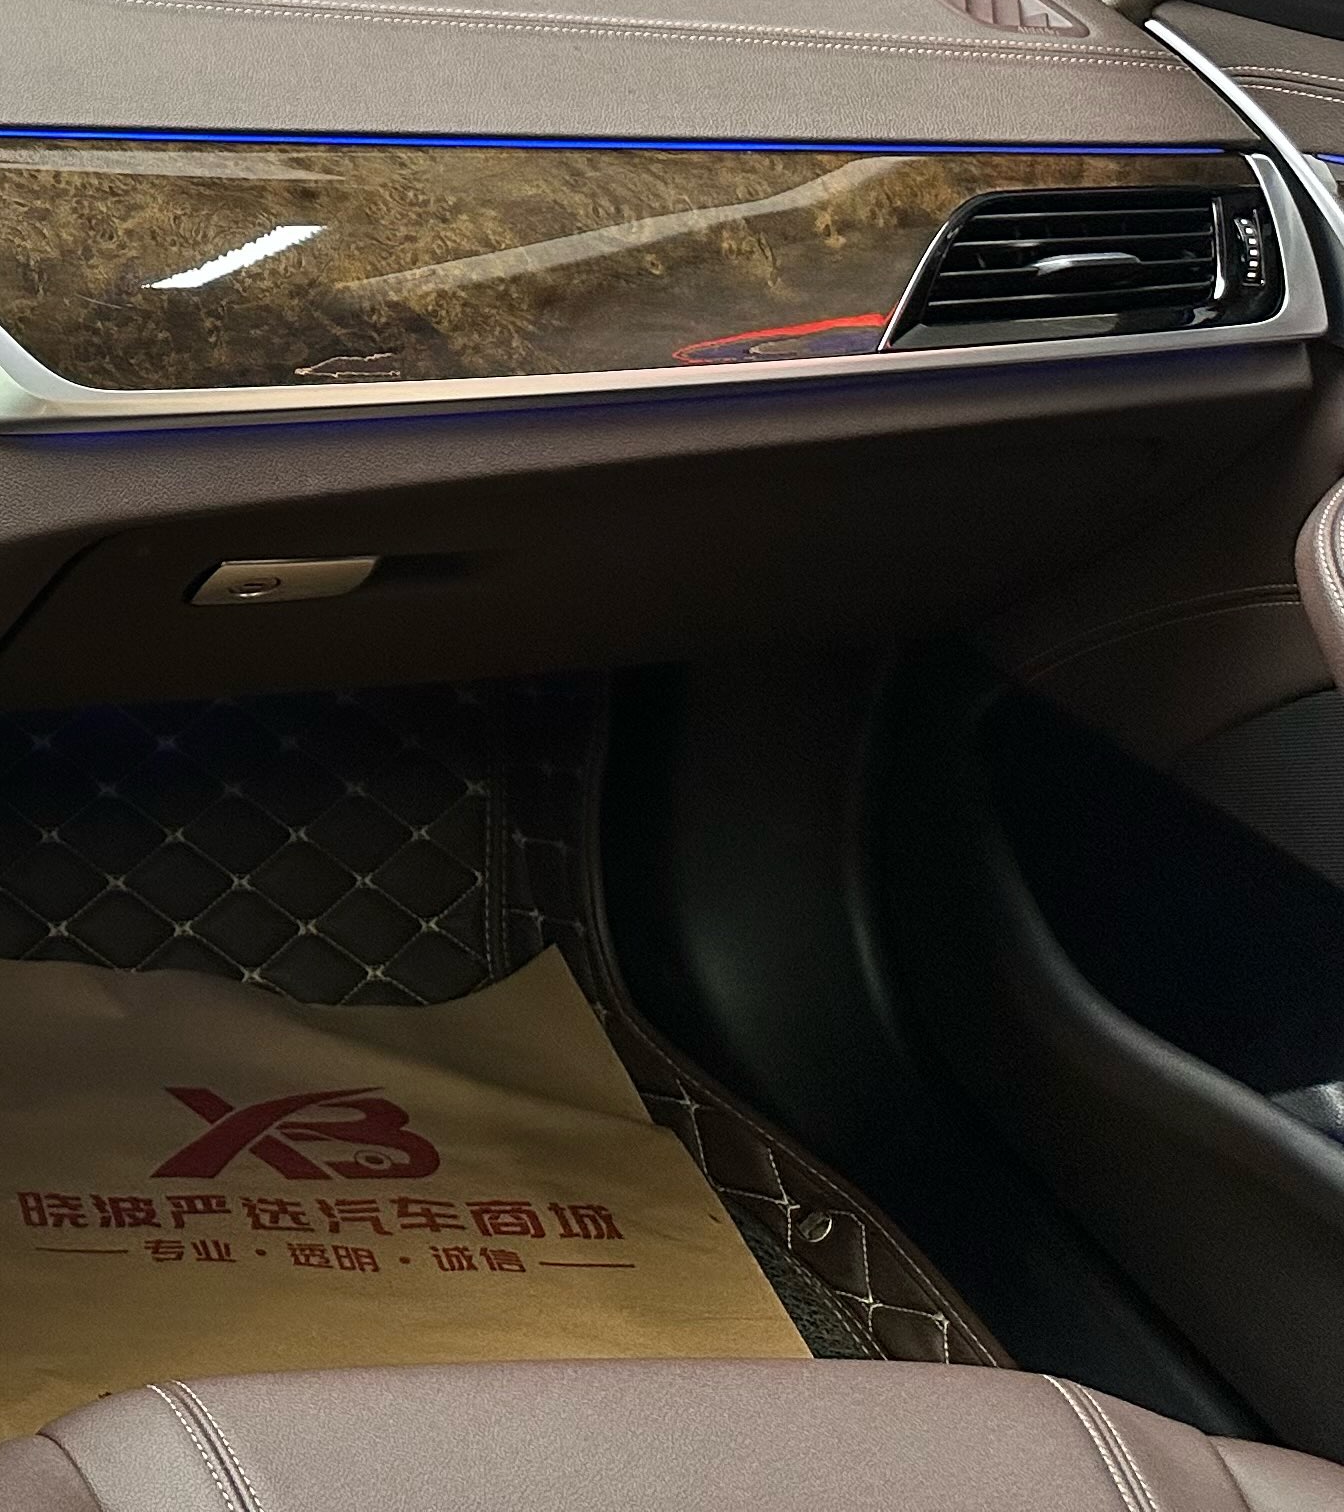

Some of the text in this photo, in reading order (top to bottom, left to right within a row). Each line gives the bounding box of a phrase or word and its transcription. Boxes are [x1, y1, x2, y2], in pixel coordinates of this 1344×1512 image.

[16, 1190, 625, 1240] 晓波严选汽车商城
